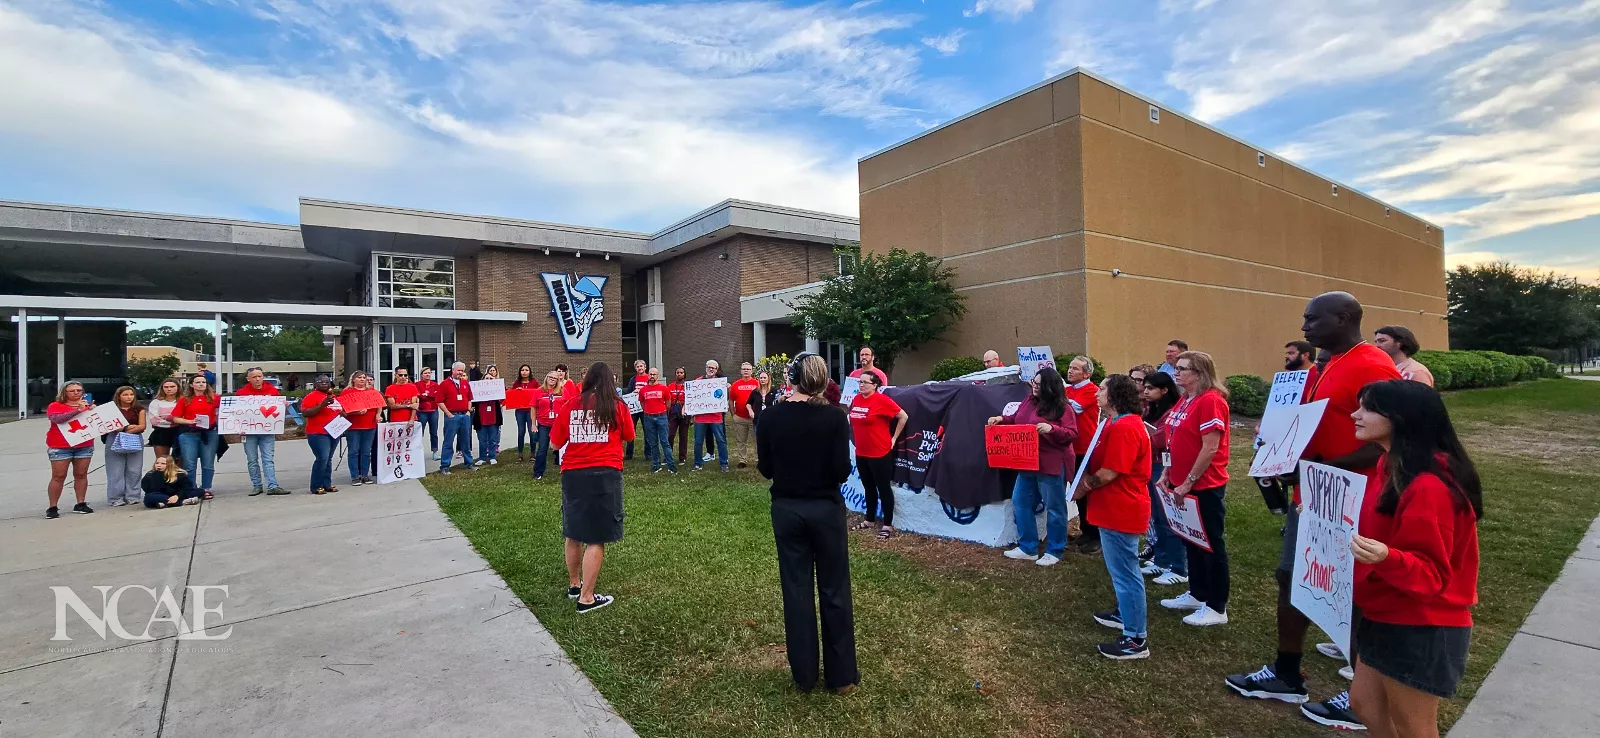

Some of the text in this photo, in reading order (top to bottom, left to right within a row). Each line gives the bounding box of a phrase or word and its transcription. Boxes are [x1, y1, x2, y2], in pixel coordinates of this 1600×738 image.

[551, 279, 577, 336] HOGGARD
[1274, 371, 1307, 385] HELENE
[1275, 392, 1297, 405] US!
[570, 434, 609, 443] MEMBER
[923, 430, 937, 440] We
[1011, 442, 1037, 458] BETTER
[1303, 546, 1336, 592] Schools
